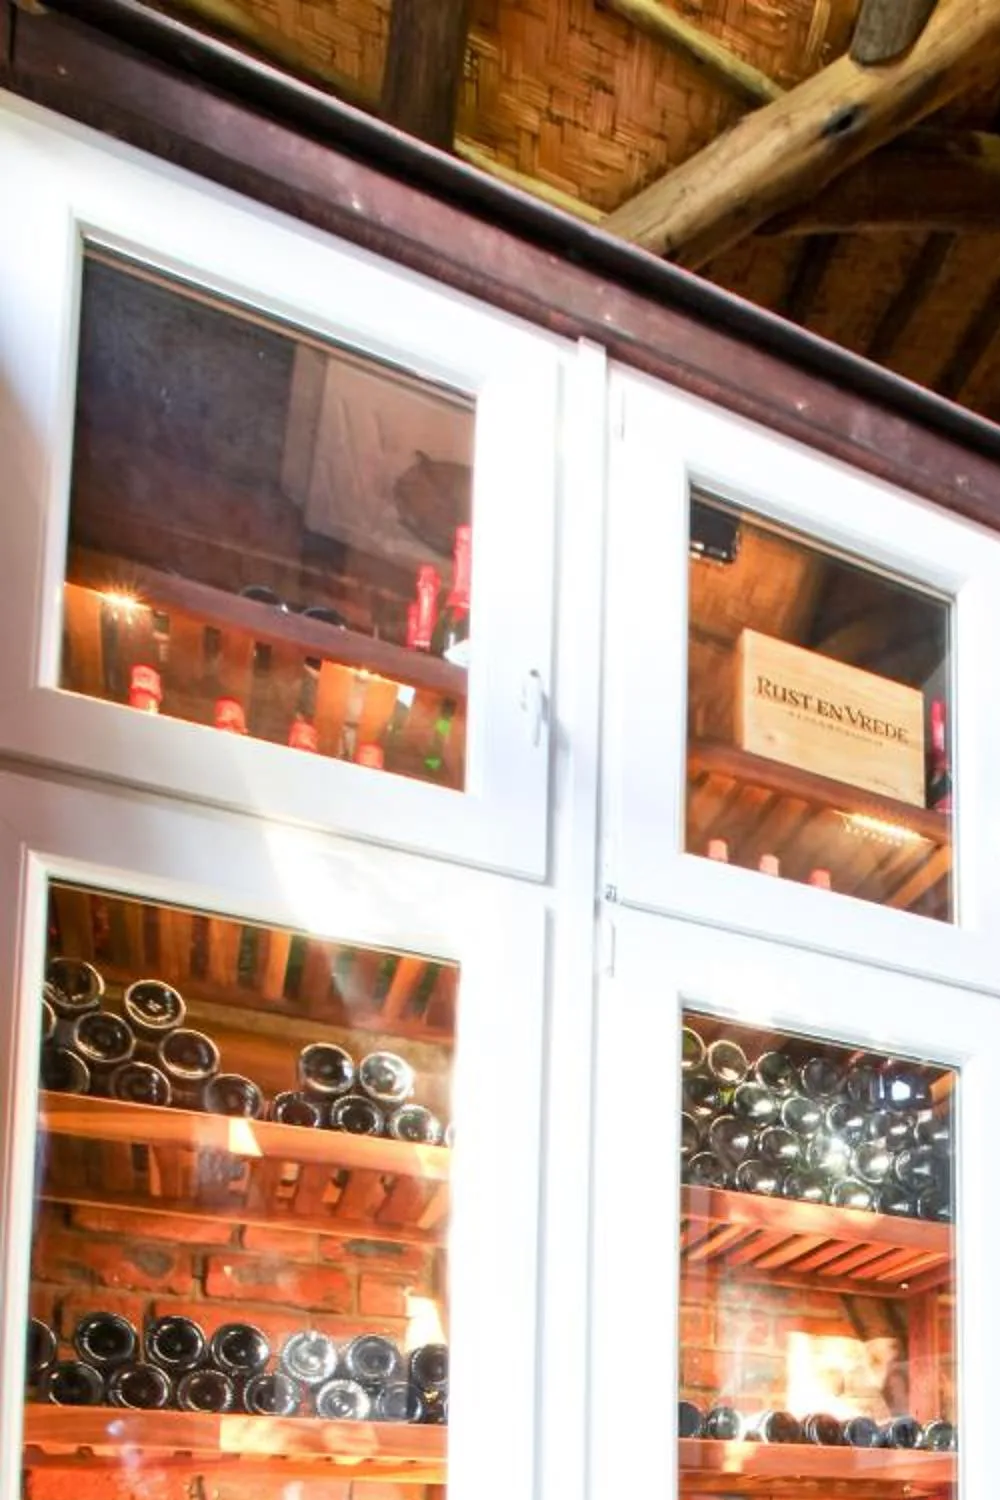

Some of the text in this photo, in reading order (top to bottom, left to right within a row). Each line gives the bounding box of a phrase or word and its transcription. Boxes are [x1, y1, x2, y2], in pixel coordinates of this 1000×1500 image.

[757, 675, 812, 710] RUST
[817, 700, 843, 721] EN
[843, 703, 909, 744] VREDE
